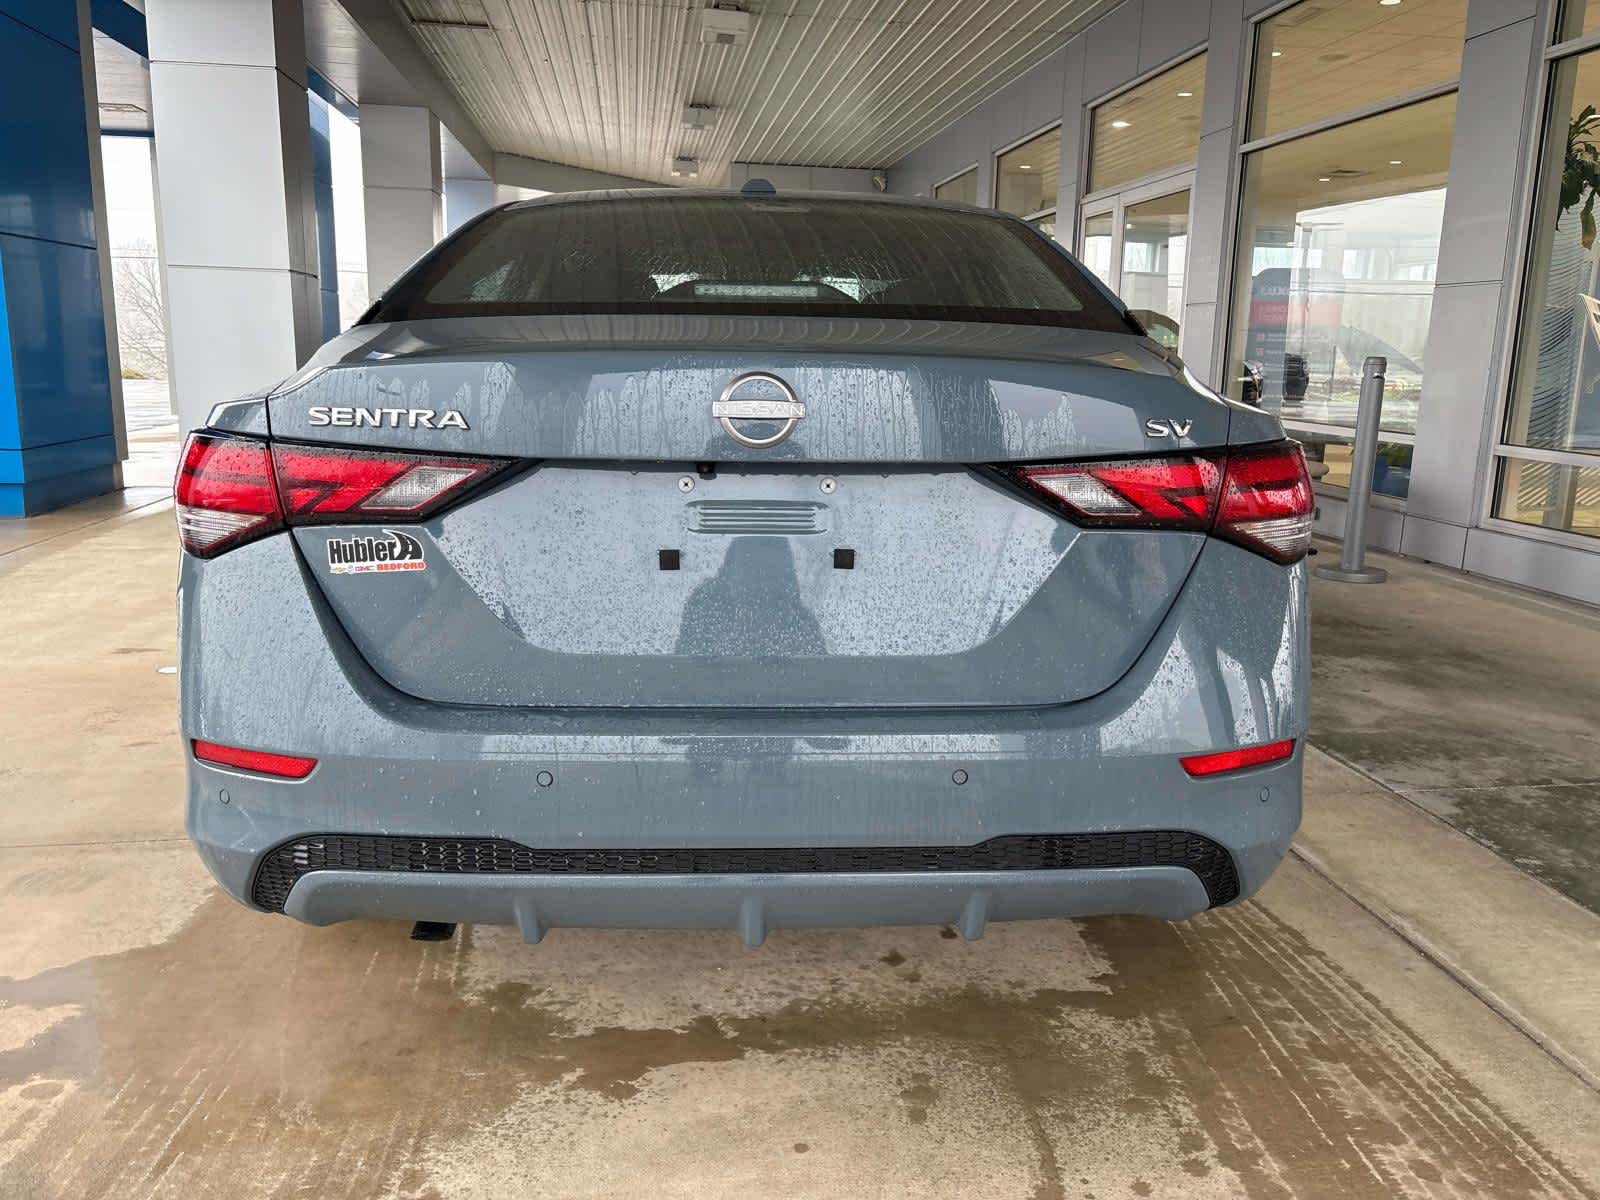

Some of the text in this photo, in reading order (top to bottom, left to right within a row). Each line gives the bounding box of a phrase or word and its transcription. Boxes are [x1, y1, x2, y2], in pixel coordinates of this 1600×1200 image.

[307, 406, 471, 430] SENTRA
[715, 402, 804, 417] NISSAN
[1145, 419, 1193, 437] SV
[327, 538, 398, 564] Hubler
[376, 561, 425, 571] BEDFORD
